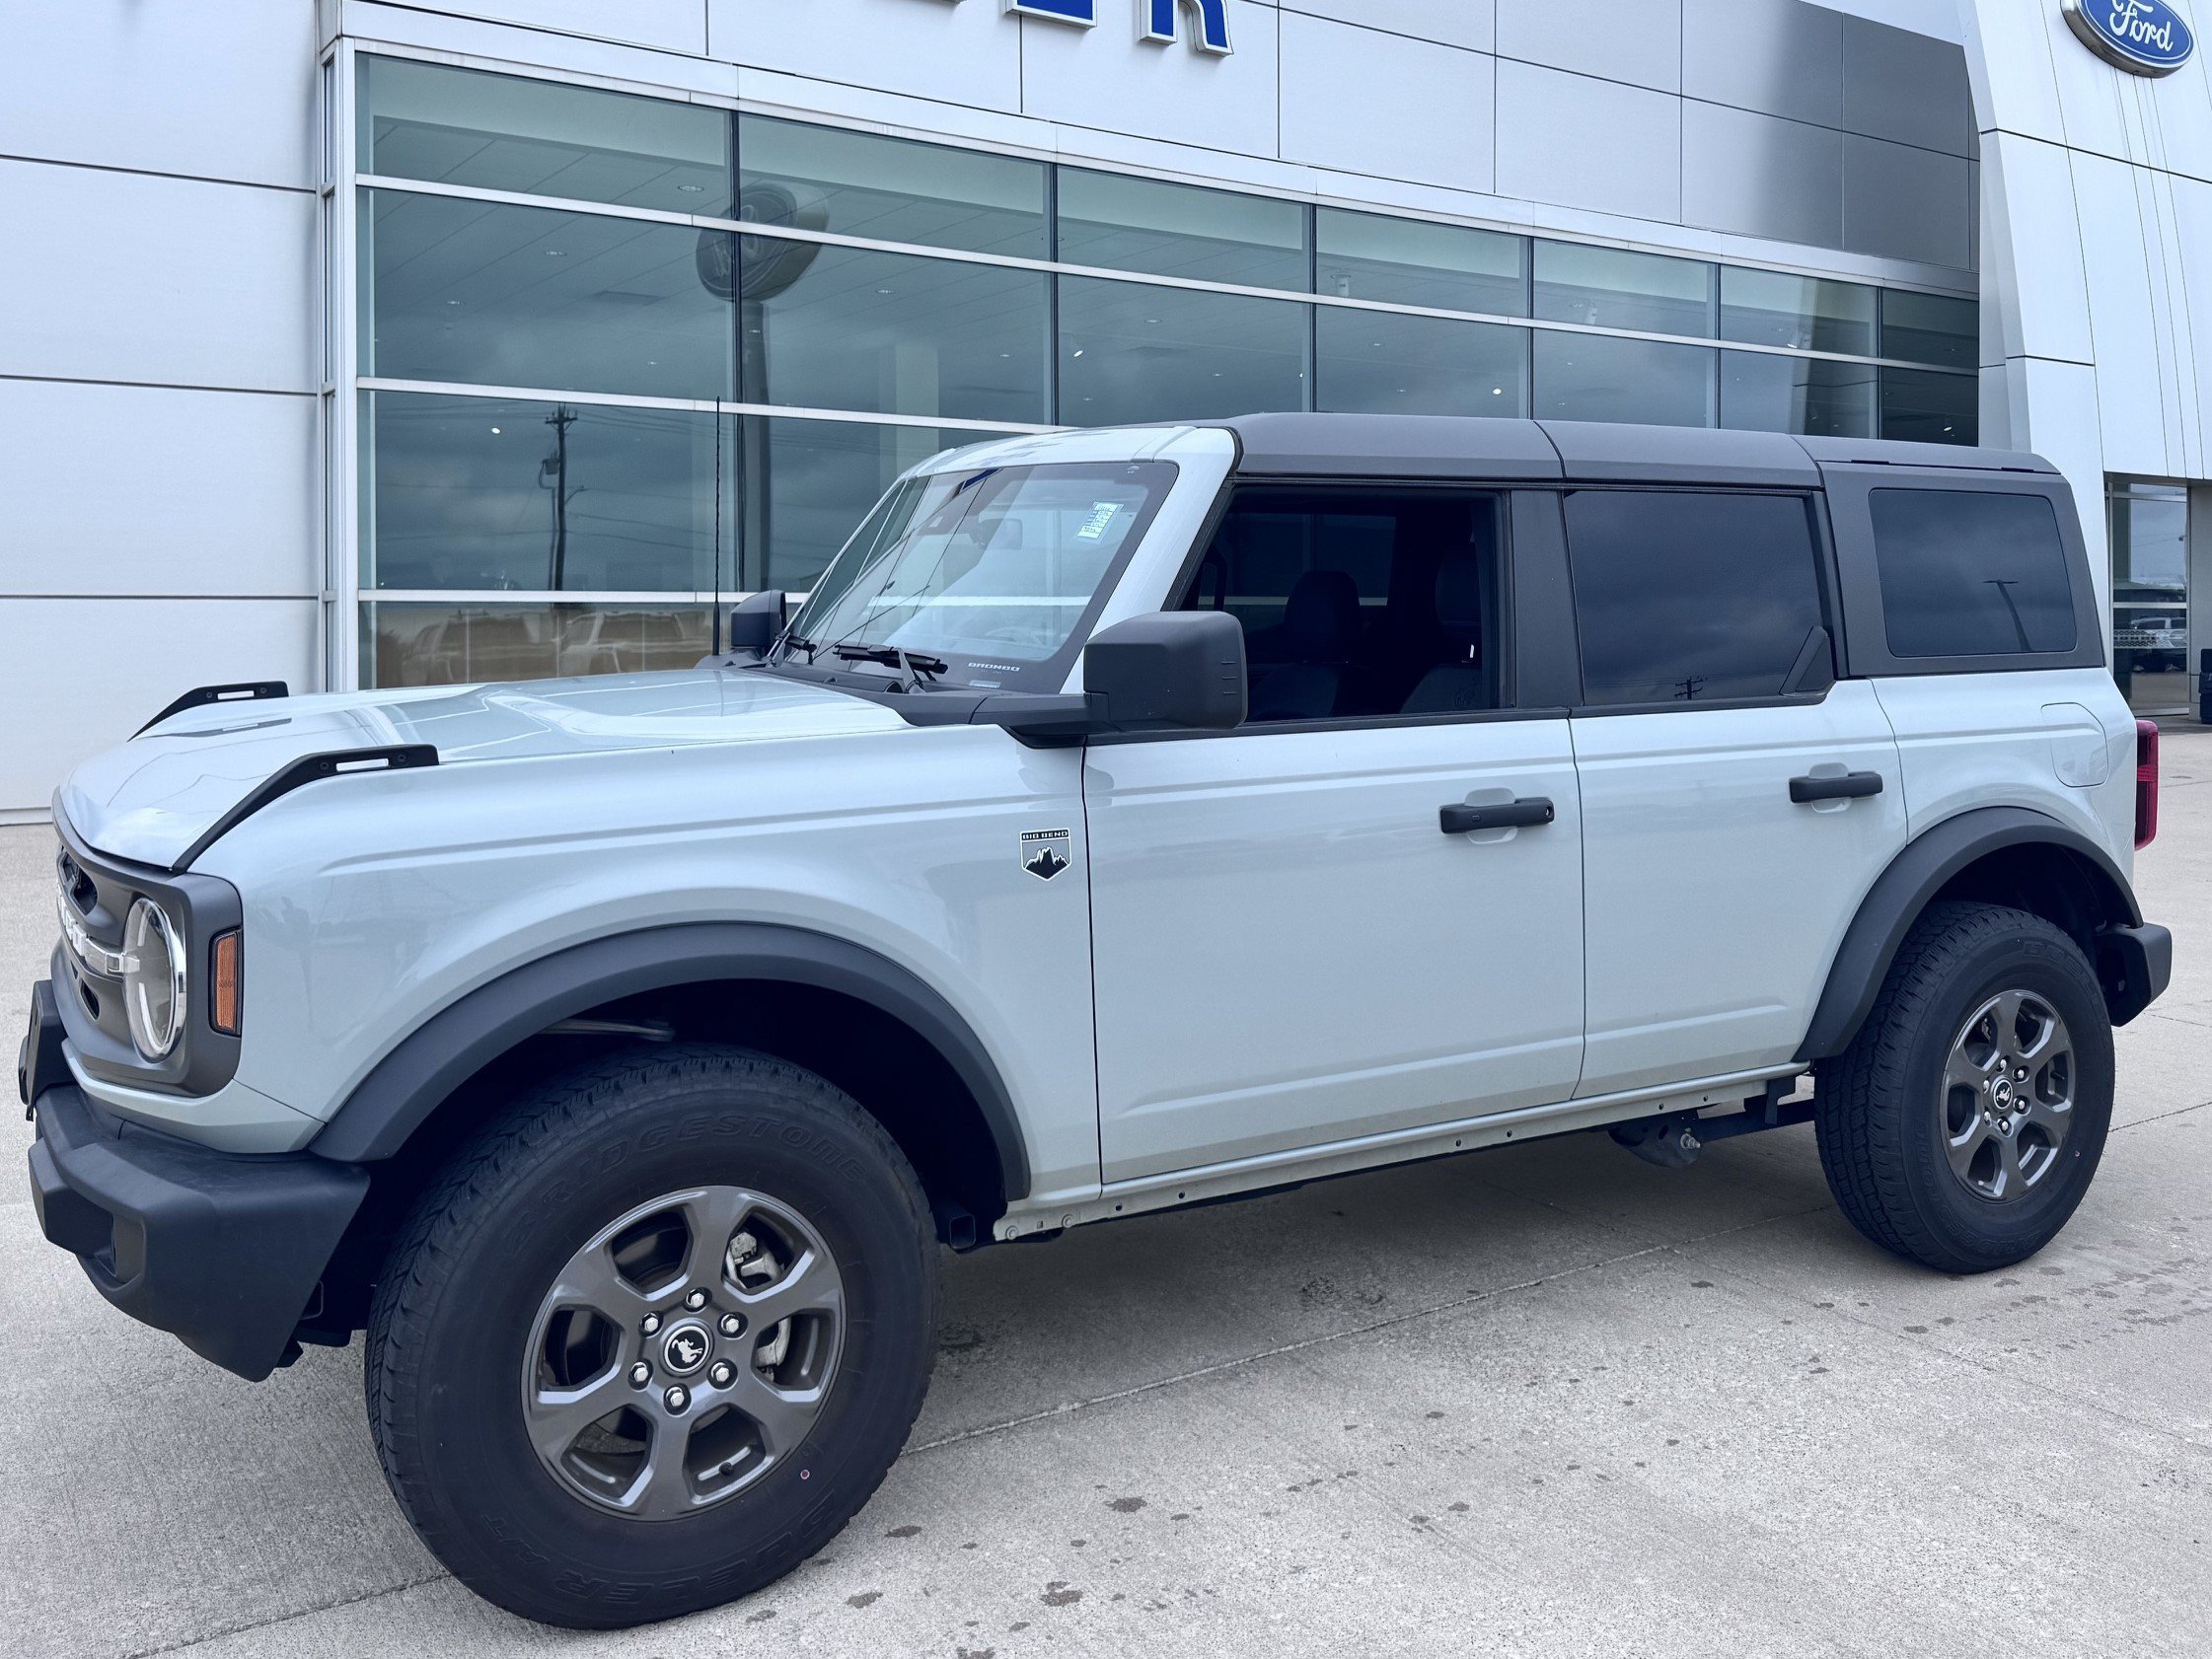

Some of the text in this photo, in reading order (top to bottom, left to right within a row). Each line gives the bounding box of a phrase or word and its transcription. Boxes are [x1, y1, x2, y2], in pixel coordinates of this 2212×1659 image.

[2109, 0, 2175, 52] Ford
[968, 662, 1021, 672] BRONCO
[501, 1110, 871, 1257] BRIDGESTONE
[552, 1486, 837, 1606] DUELER
